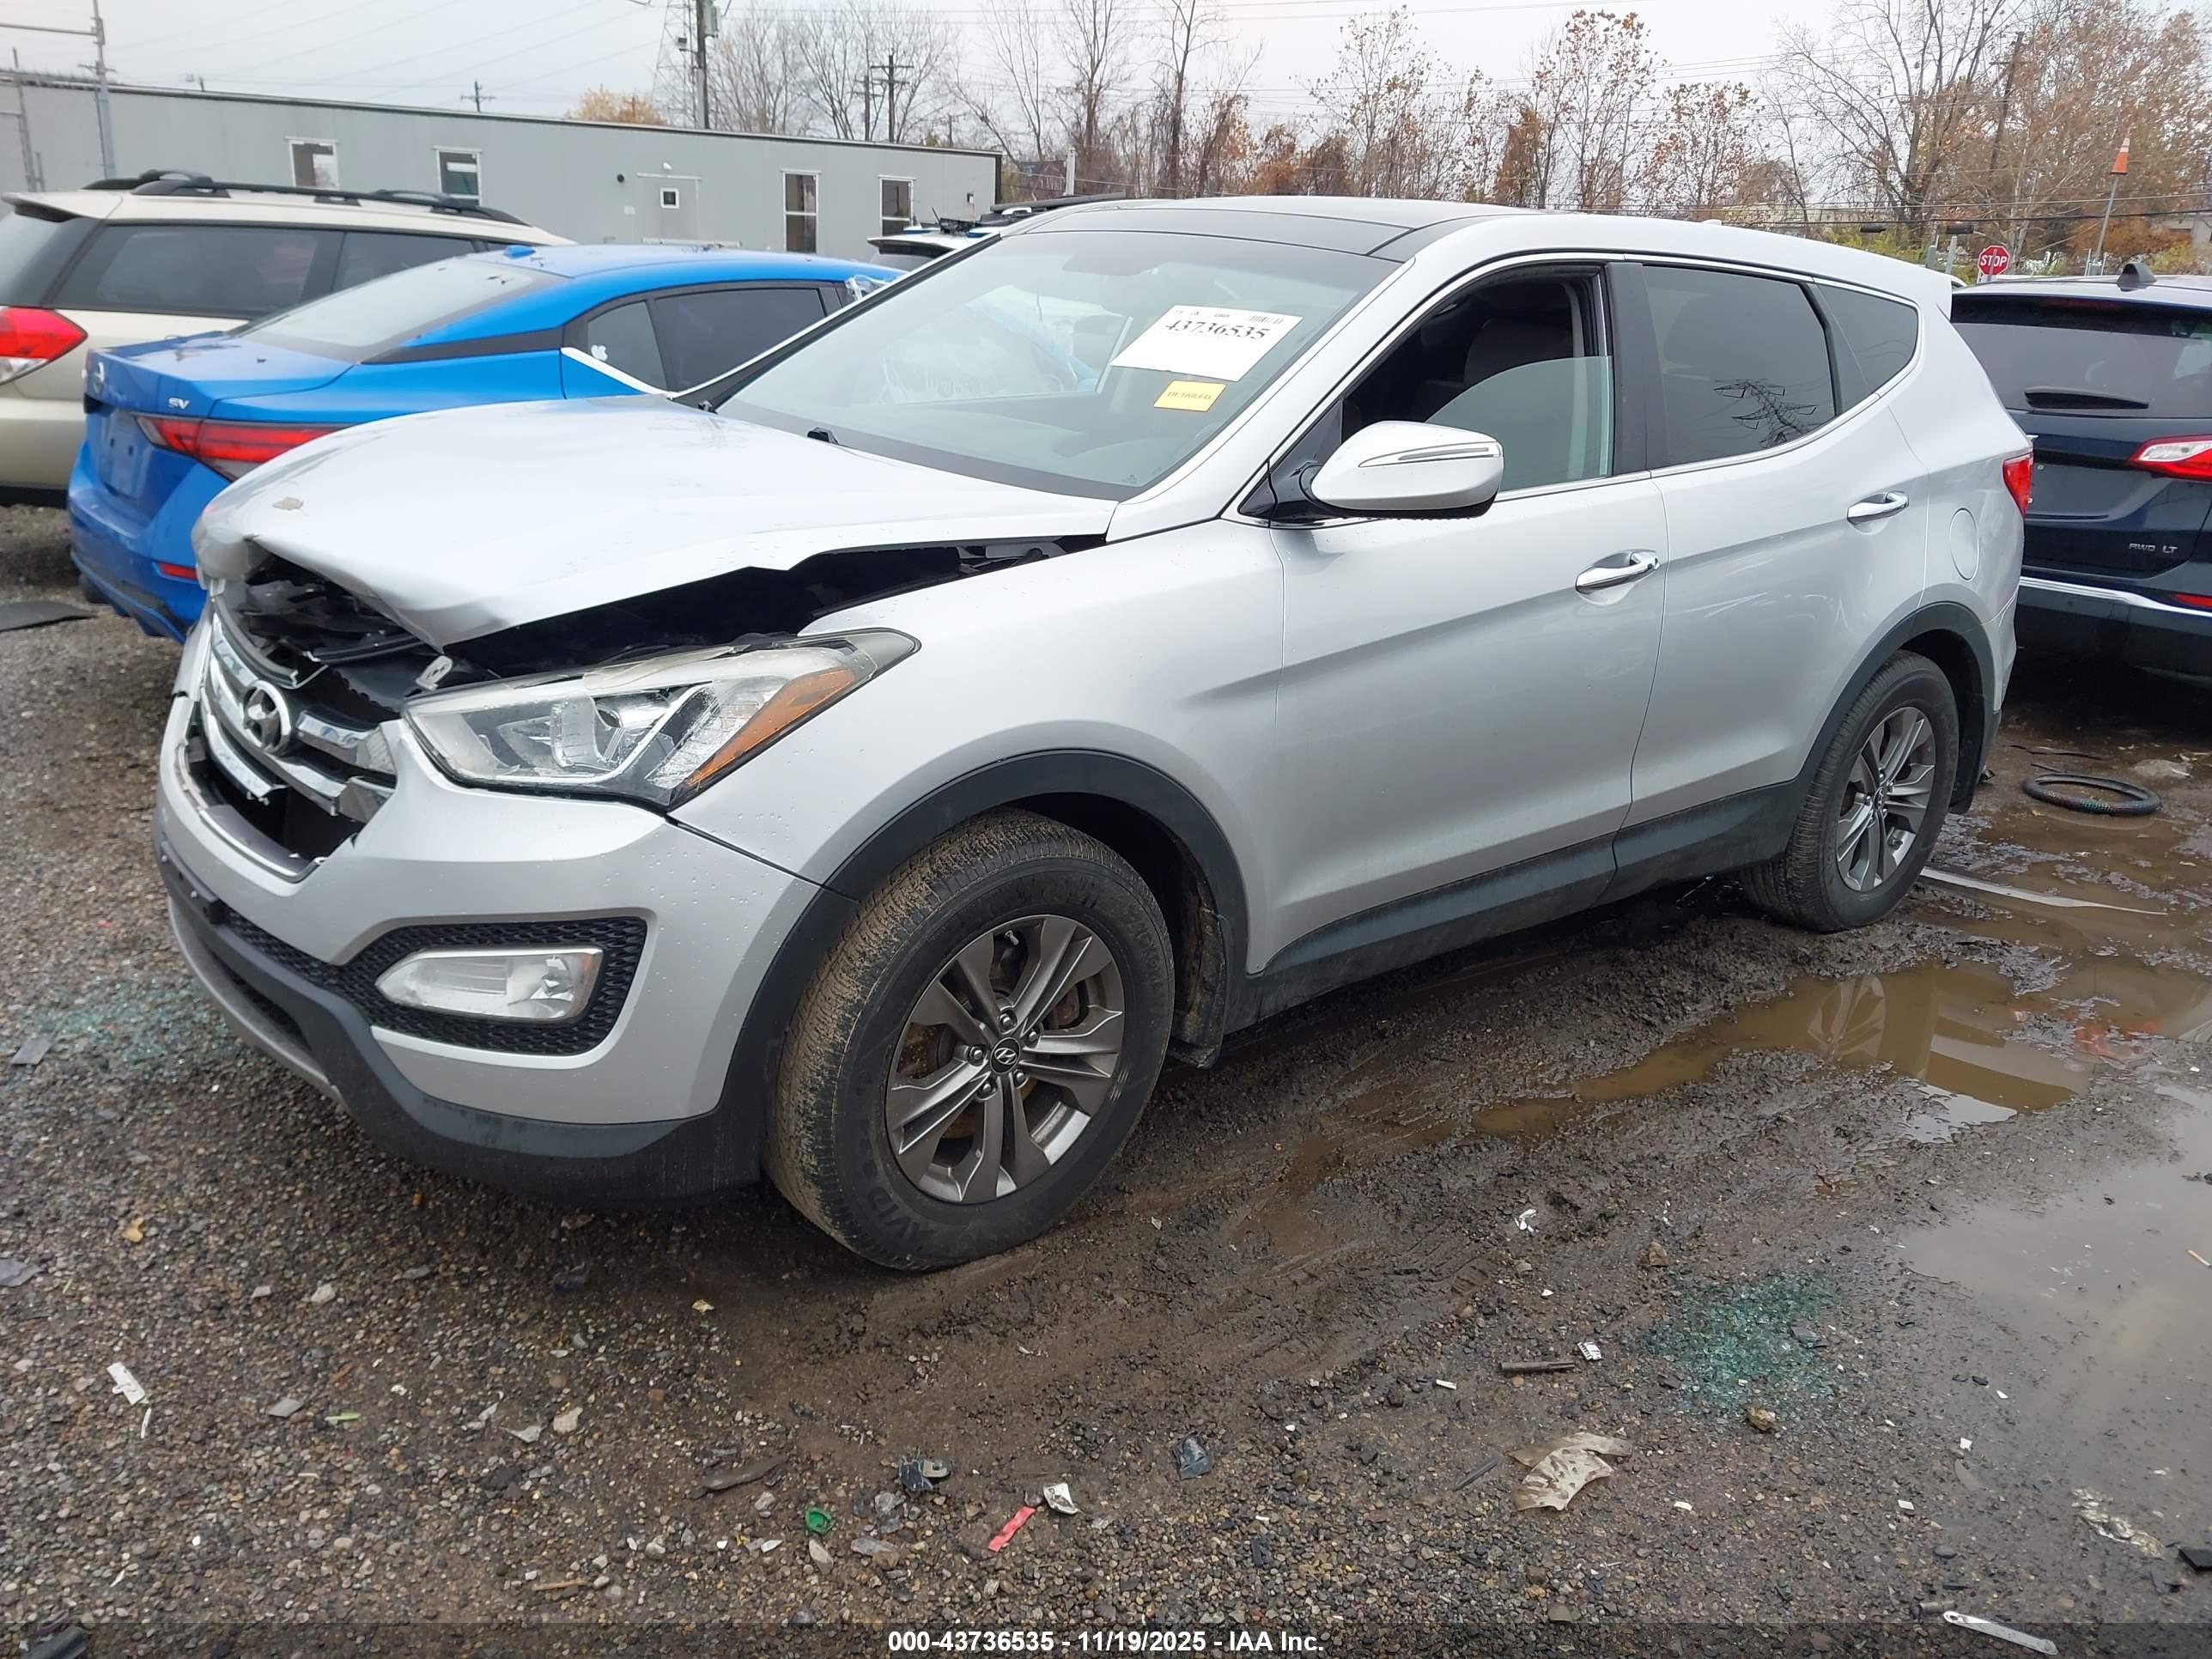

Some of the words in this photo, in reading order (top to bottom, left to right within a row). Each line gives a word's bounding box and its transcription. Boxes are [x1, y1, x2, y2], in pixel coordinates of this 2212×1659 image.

[1980, 255, 2008, 267] STOP
[1165, 320, 1271, 339] 43736535
[167, 398, 190, 410] SV
[2129, 543, 2156, 551] AWD
[2162, 545, 2179, 554] LT
